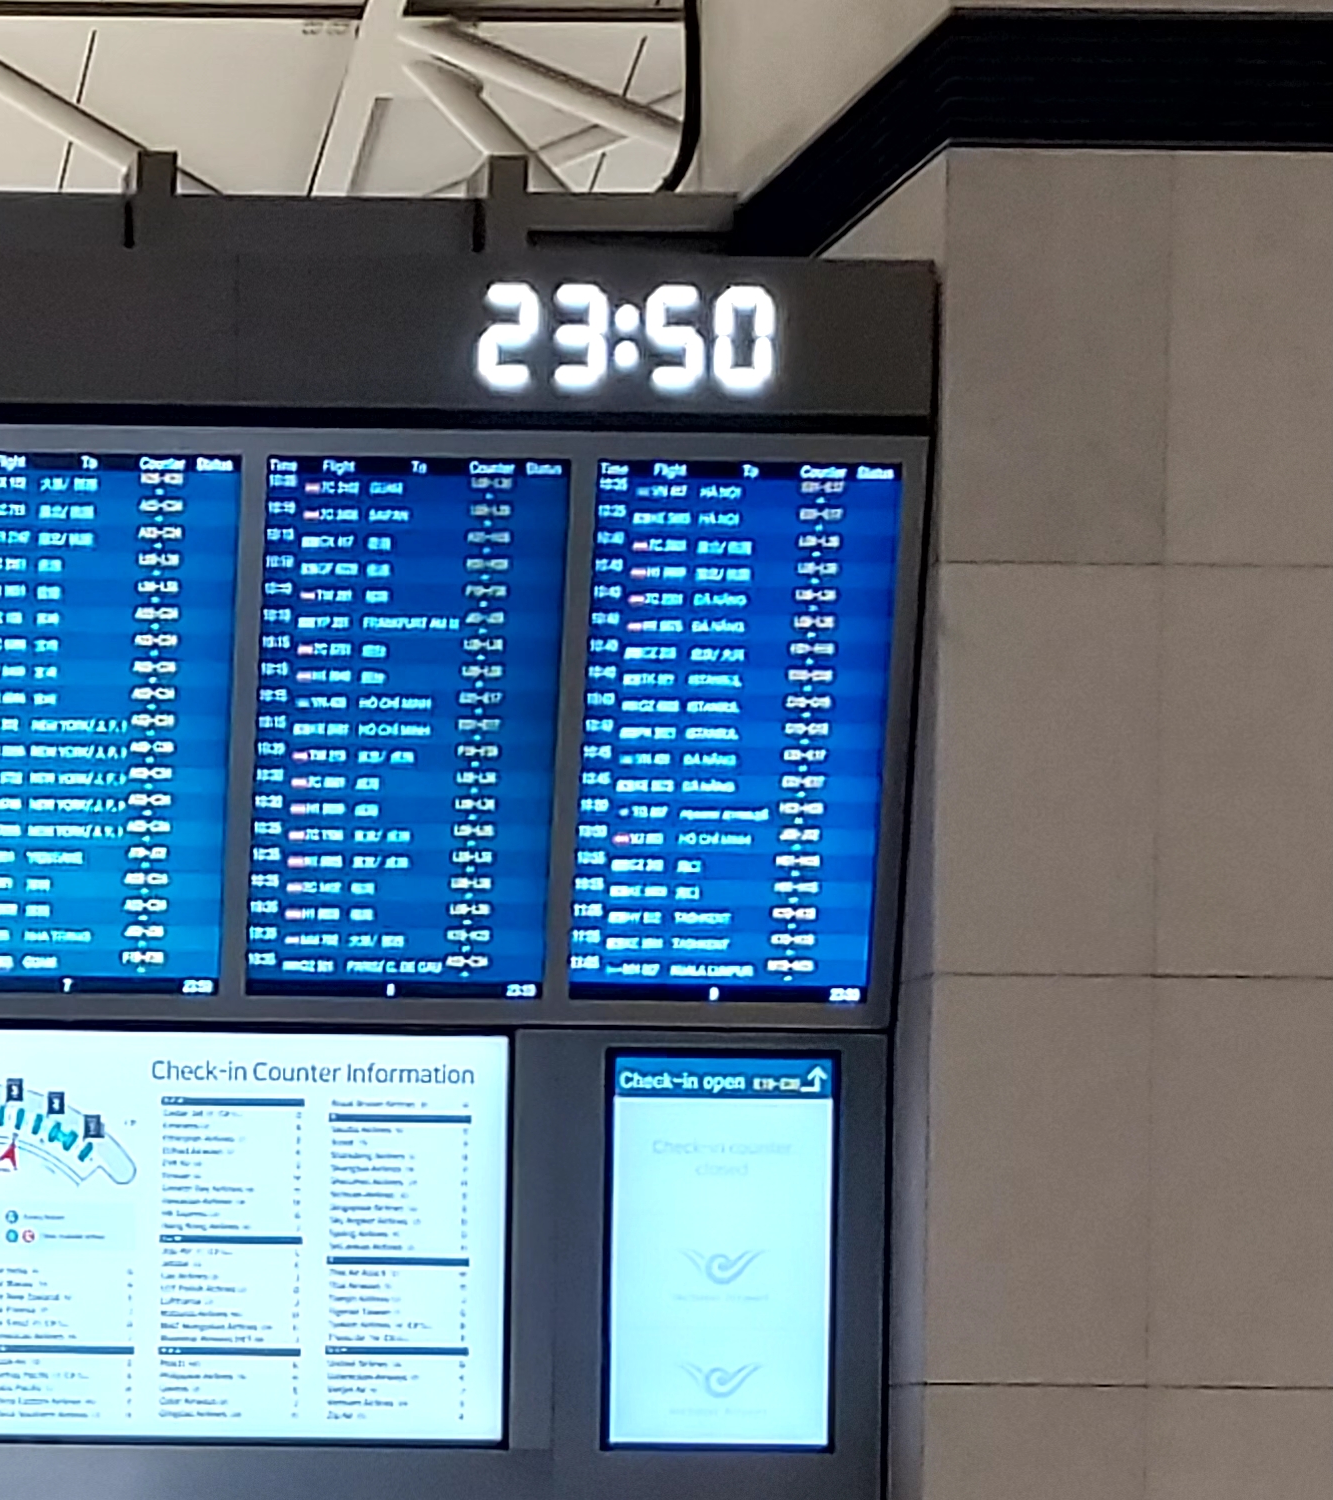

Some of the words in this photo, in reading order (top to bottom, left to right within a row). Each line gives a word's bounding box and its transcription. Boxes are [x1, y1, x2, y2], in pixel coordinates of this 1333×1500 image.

[476, 282, 776, 393] 23:50
[80, 455, 99, 470] To
[139, 456, 186, 471] Counter
[196, 456, 234, 472] Status
[269, 458, 298, 472] Time
[322, 459, 356, 476] Flight
[411, 460, 427, 474] To
[469, 460, 516, 475] Counter
[525, 461, 563, 475] Status
[600, 462, 629, 475] Time
[653, 462, 687, 480] Flight
[742, 463, 760, 478] To
[799, 464, 848, 479] Counter
[856, 465, 895, 480] Status
[62, 977, 73, 993] 7
[151, 1060, 248, 1081] Check-in
[252, 1062, 342, 1083] Counter
[346, 1064, 475, 1084] Information
[619, 1071, 699, 1089] Check-in
[702, 1076, 746, 1093] open
